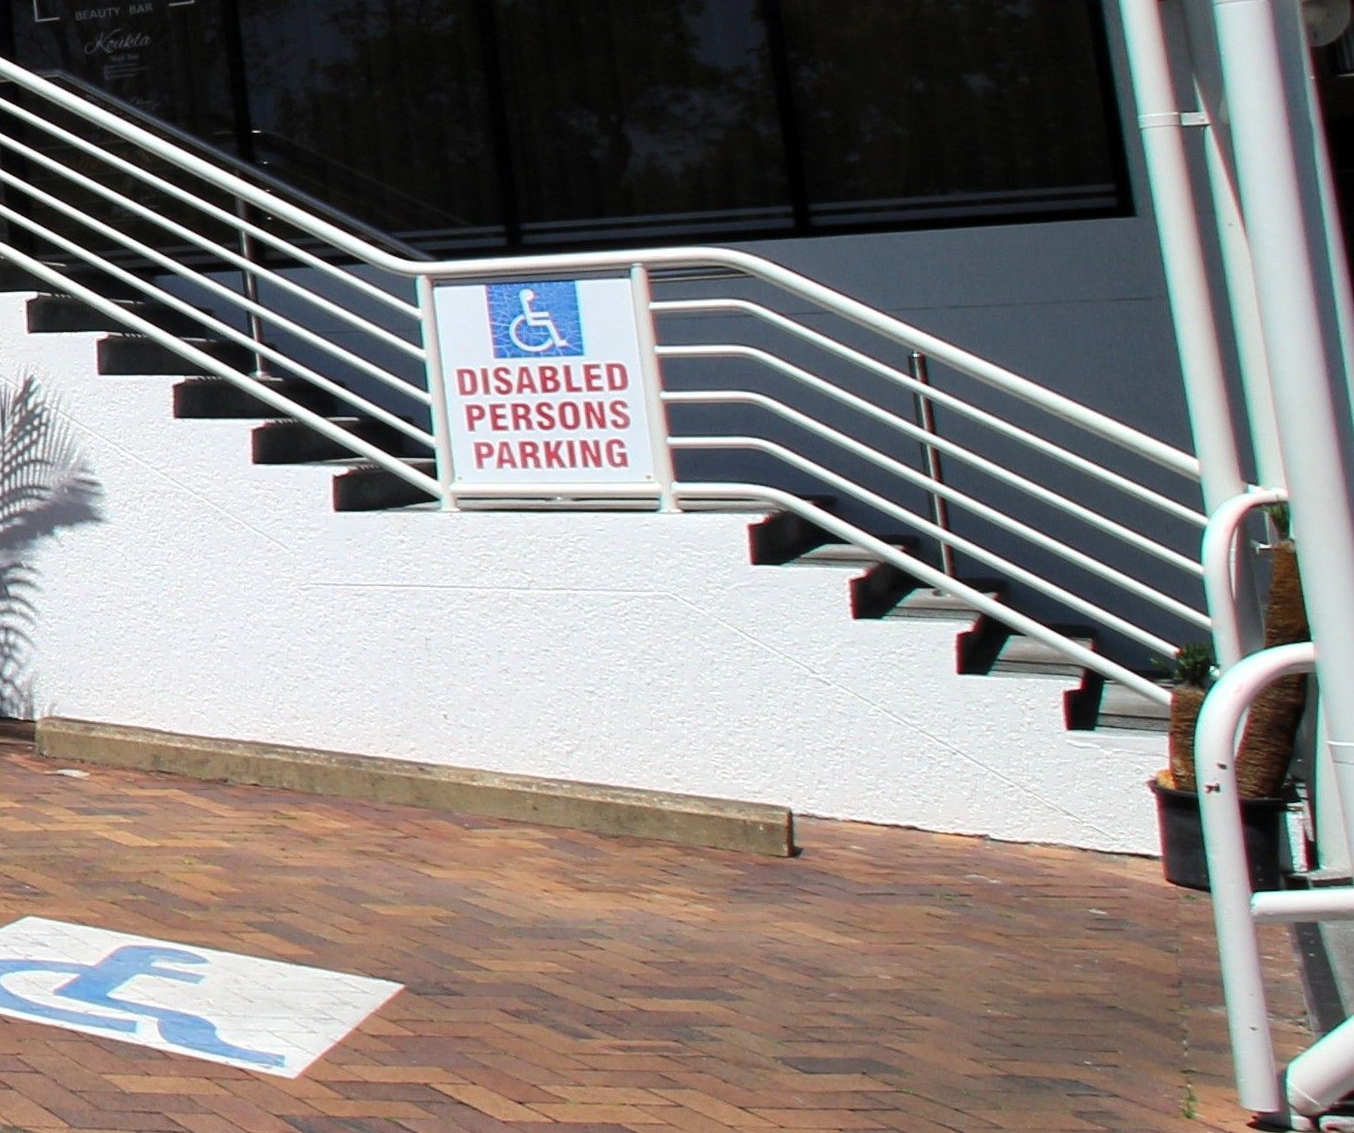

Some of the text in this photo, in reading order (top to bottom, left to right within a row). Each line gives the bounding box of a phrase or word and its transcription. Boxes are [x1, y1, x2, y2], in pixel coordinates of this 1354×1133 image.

[75, 3, 154, 21] BEAUTY BAR
[456, 362, 630, 396] DISABLED
[465, 399, 631, 432] PERSONS
[473, 438, 630, 470] PARKING
